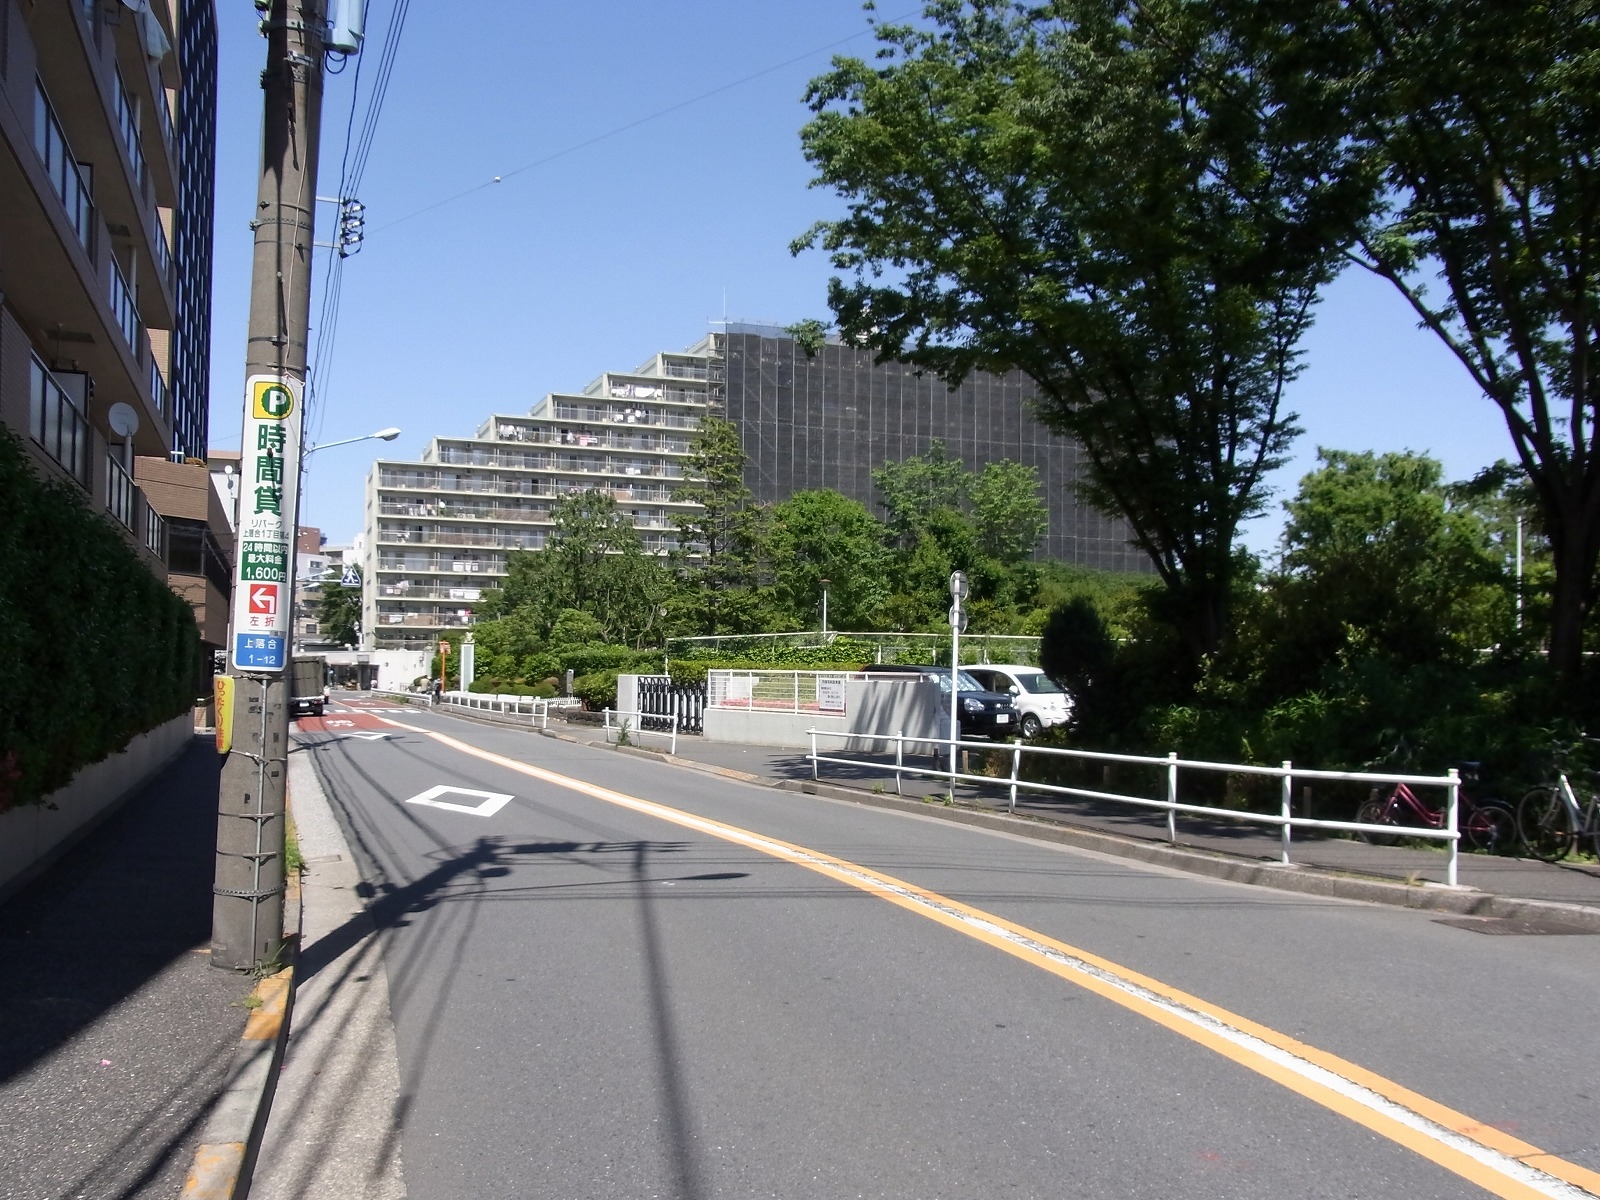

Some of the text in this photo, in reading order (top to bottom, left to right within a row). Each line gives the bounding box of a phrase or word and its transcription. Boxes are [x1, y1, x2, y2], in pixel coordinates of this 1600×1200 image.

[253, 424, 286, 517] 時間貸
[243, 542, 288, 555] 24時間以内
[247, 554, 283, 565] 最大料金
[246, 566, 286, 581] 1,600円
[244, 638, 277, 650] 上落合
